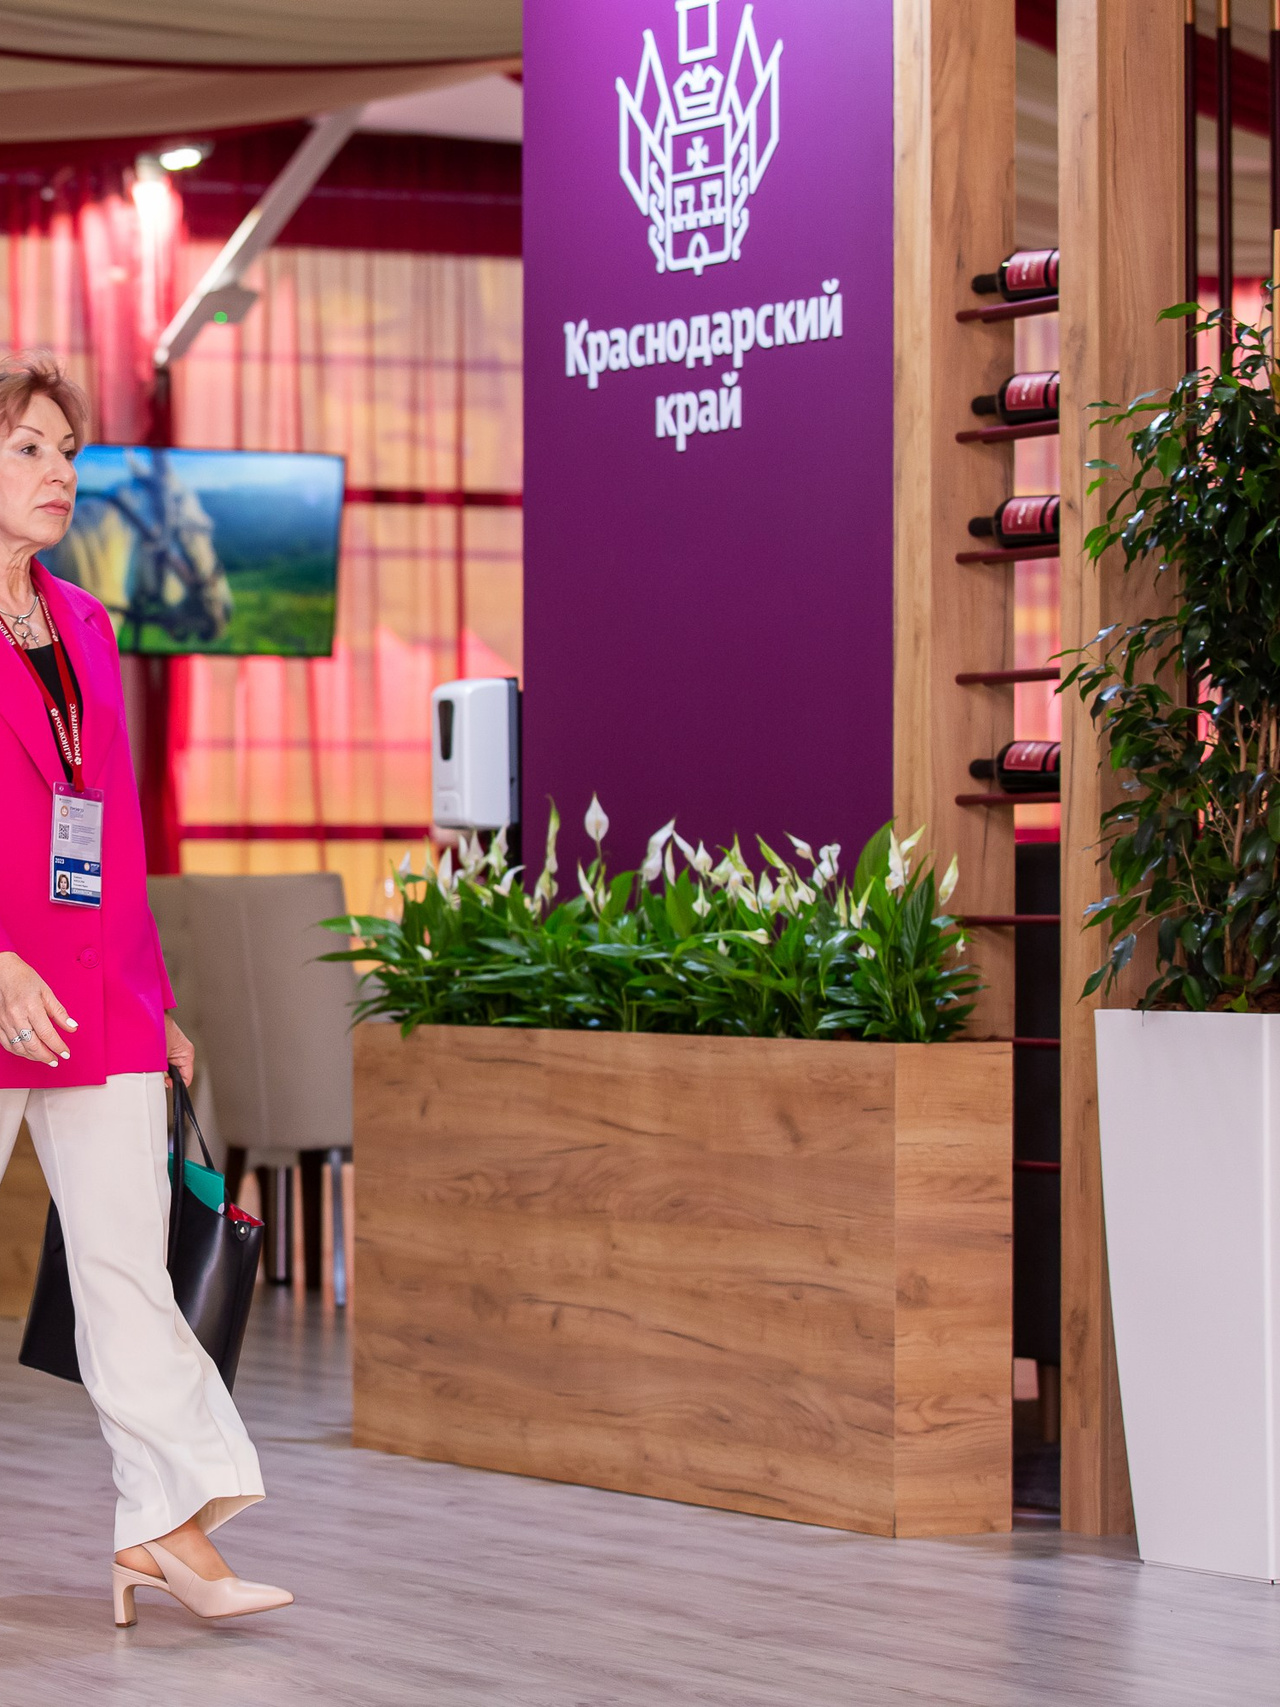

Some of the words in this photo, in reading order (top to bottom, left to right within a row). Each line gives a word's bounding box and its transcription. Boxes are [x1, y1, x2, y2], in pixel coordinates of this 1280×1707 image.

[564, 278, 843, 389] Краснодарский
[656, 371, 742, 452] край
[69, 703, 81, 757] РОСКОНГРЕСС
